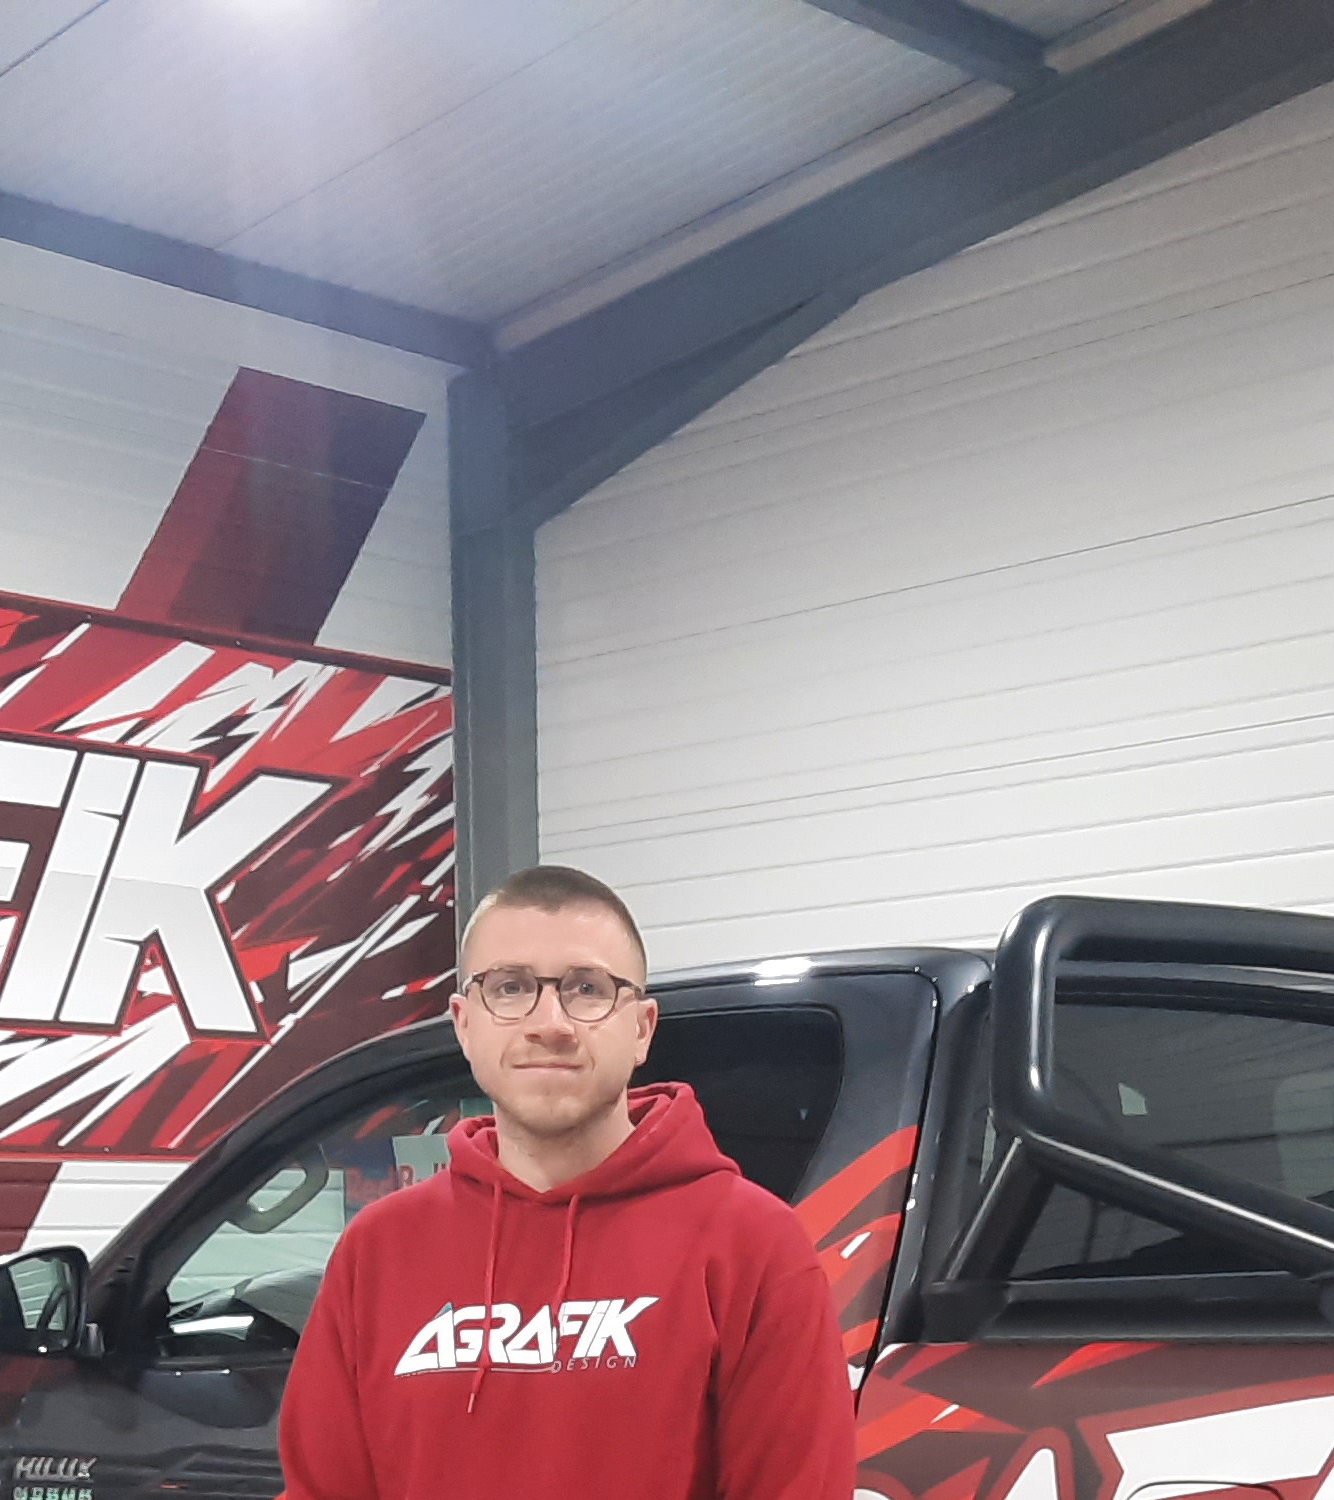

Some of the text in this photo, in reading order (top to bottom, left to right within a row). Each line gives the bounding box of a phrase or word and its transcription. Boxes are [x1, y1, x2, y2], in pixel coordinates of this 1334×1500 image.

[394, 1295, 660, 1377] AGRAFIK
[551, 1355, 637, 1374] DESIGN
[15, 1455, 98, 1480] HILUX
